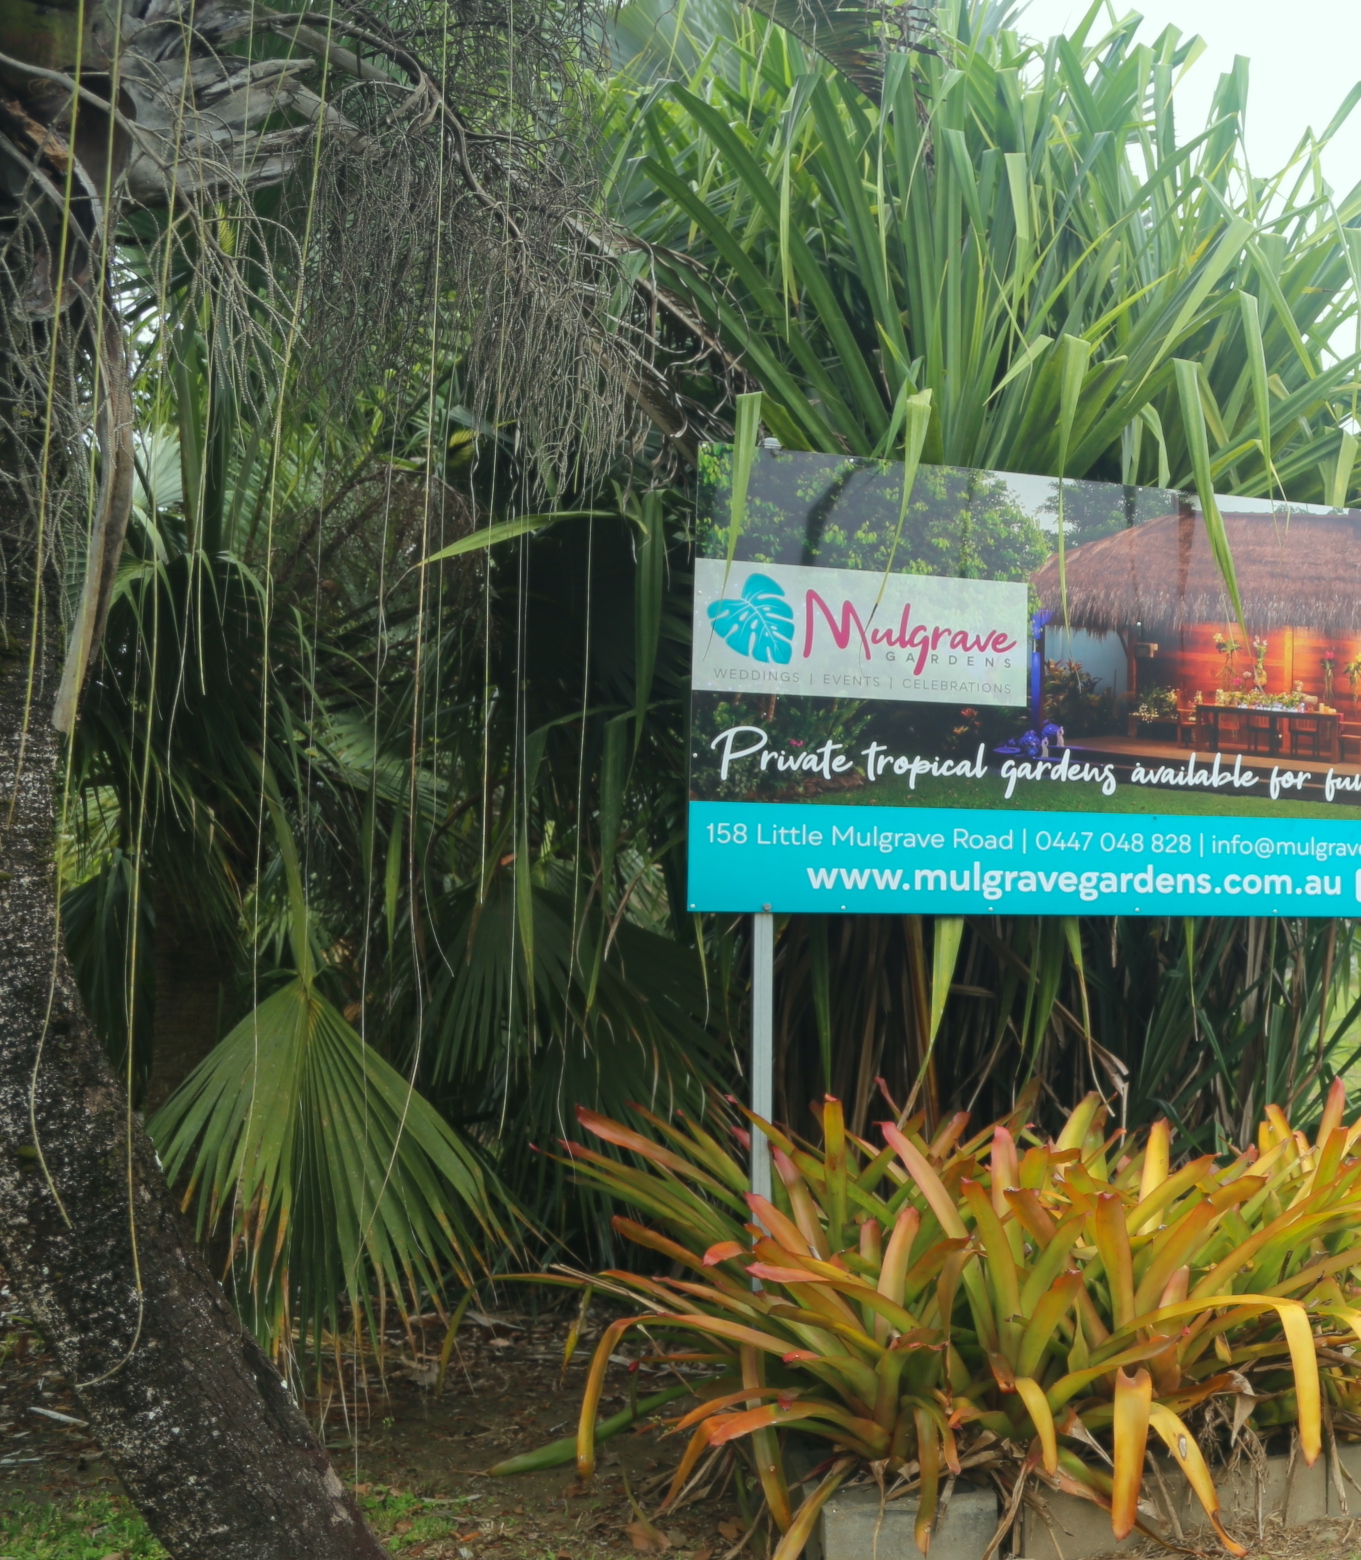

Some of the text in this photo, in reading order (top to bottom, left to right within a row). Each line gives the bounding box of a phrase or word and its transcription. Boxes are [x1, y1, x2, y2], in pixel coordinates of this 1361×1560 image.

[803, 589, 1017, 675] Mulgrave
[886, 651, 1012, 669] GARDENS
[714, 668, 800, 683] WEDDINGS
[823, 674, 880, 687] EVENTS
[902, 678, 1011, 695] CELEBRATIONS
[710, 725, 854, 781] Private
[861, 741, 988, 789] tropical
[1001, 749, 1116, 798] gardens
[1131, 752, 1259, 788] available
[1269, 765, 1311, 799] for
[706, 822, 748, 844] 158
[757, 823, 823, 846] Little
[832, 825, 945, 853] Mulgrave
[953, 828, 1014, 850] Road
[1035, 831, 1093, 851] 0447
[1100, 832, 1144, 853] 048
[1151, 833, 1192, 854] 828
[807, 861, 1342, 901] www.mulgravegardens.com.au
